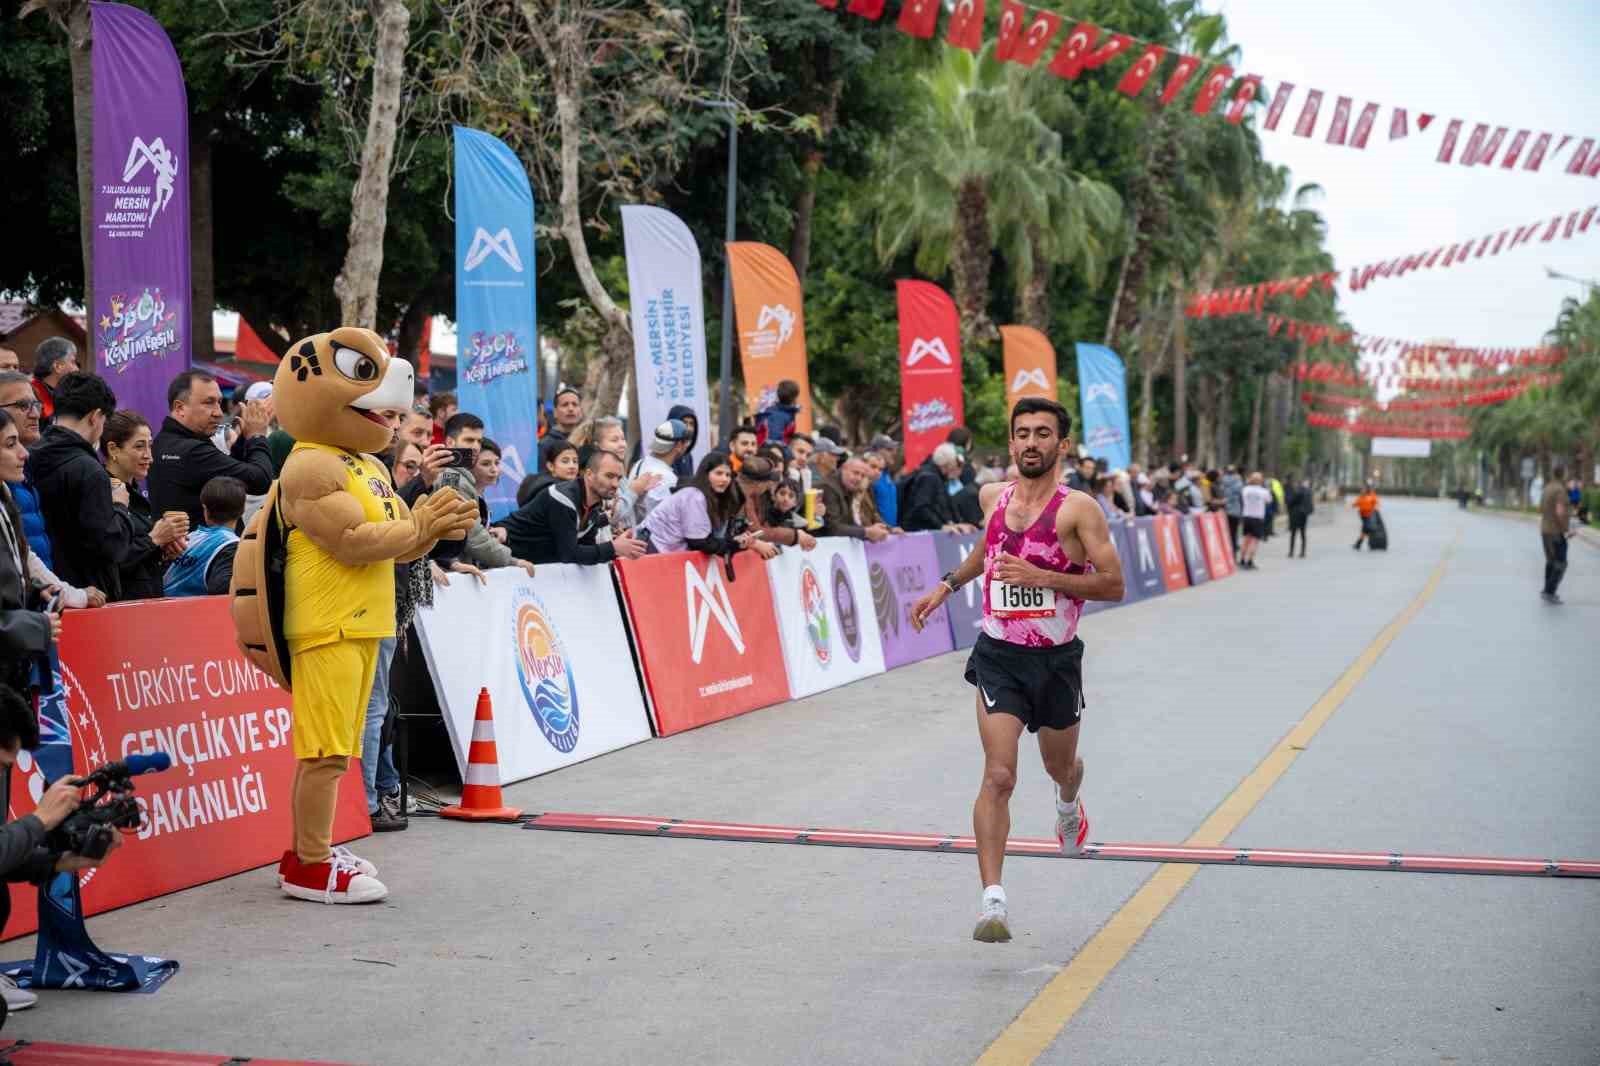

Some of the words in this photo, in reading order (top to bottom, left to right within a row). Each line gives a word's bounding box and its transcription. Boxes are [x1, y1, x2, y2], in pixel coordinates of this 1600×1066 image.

[104, 211, 147, 223] MARATONU
[114, 195, 151, 210] MERSİN
[643, 297, 663, 366] MERSİN
[676, 304, 697, 399] BELEDİYESİ
[1001, 585, 1044, 607] 1566
[106, 657, 200, 711] TÜRKİYE
[229, 712, 263, 755] VE
